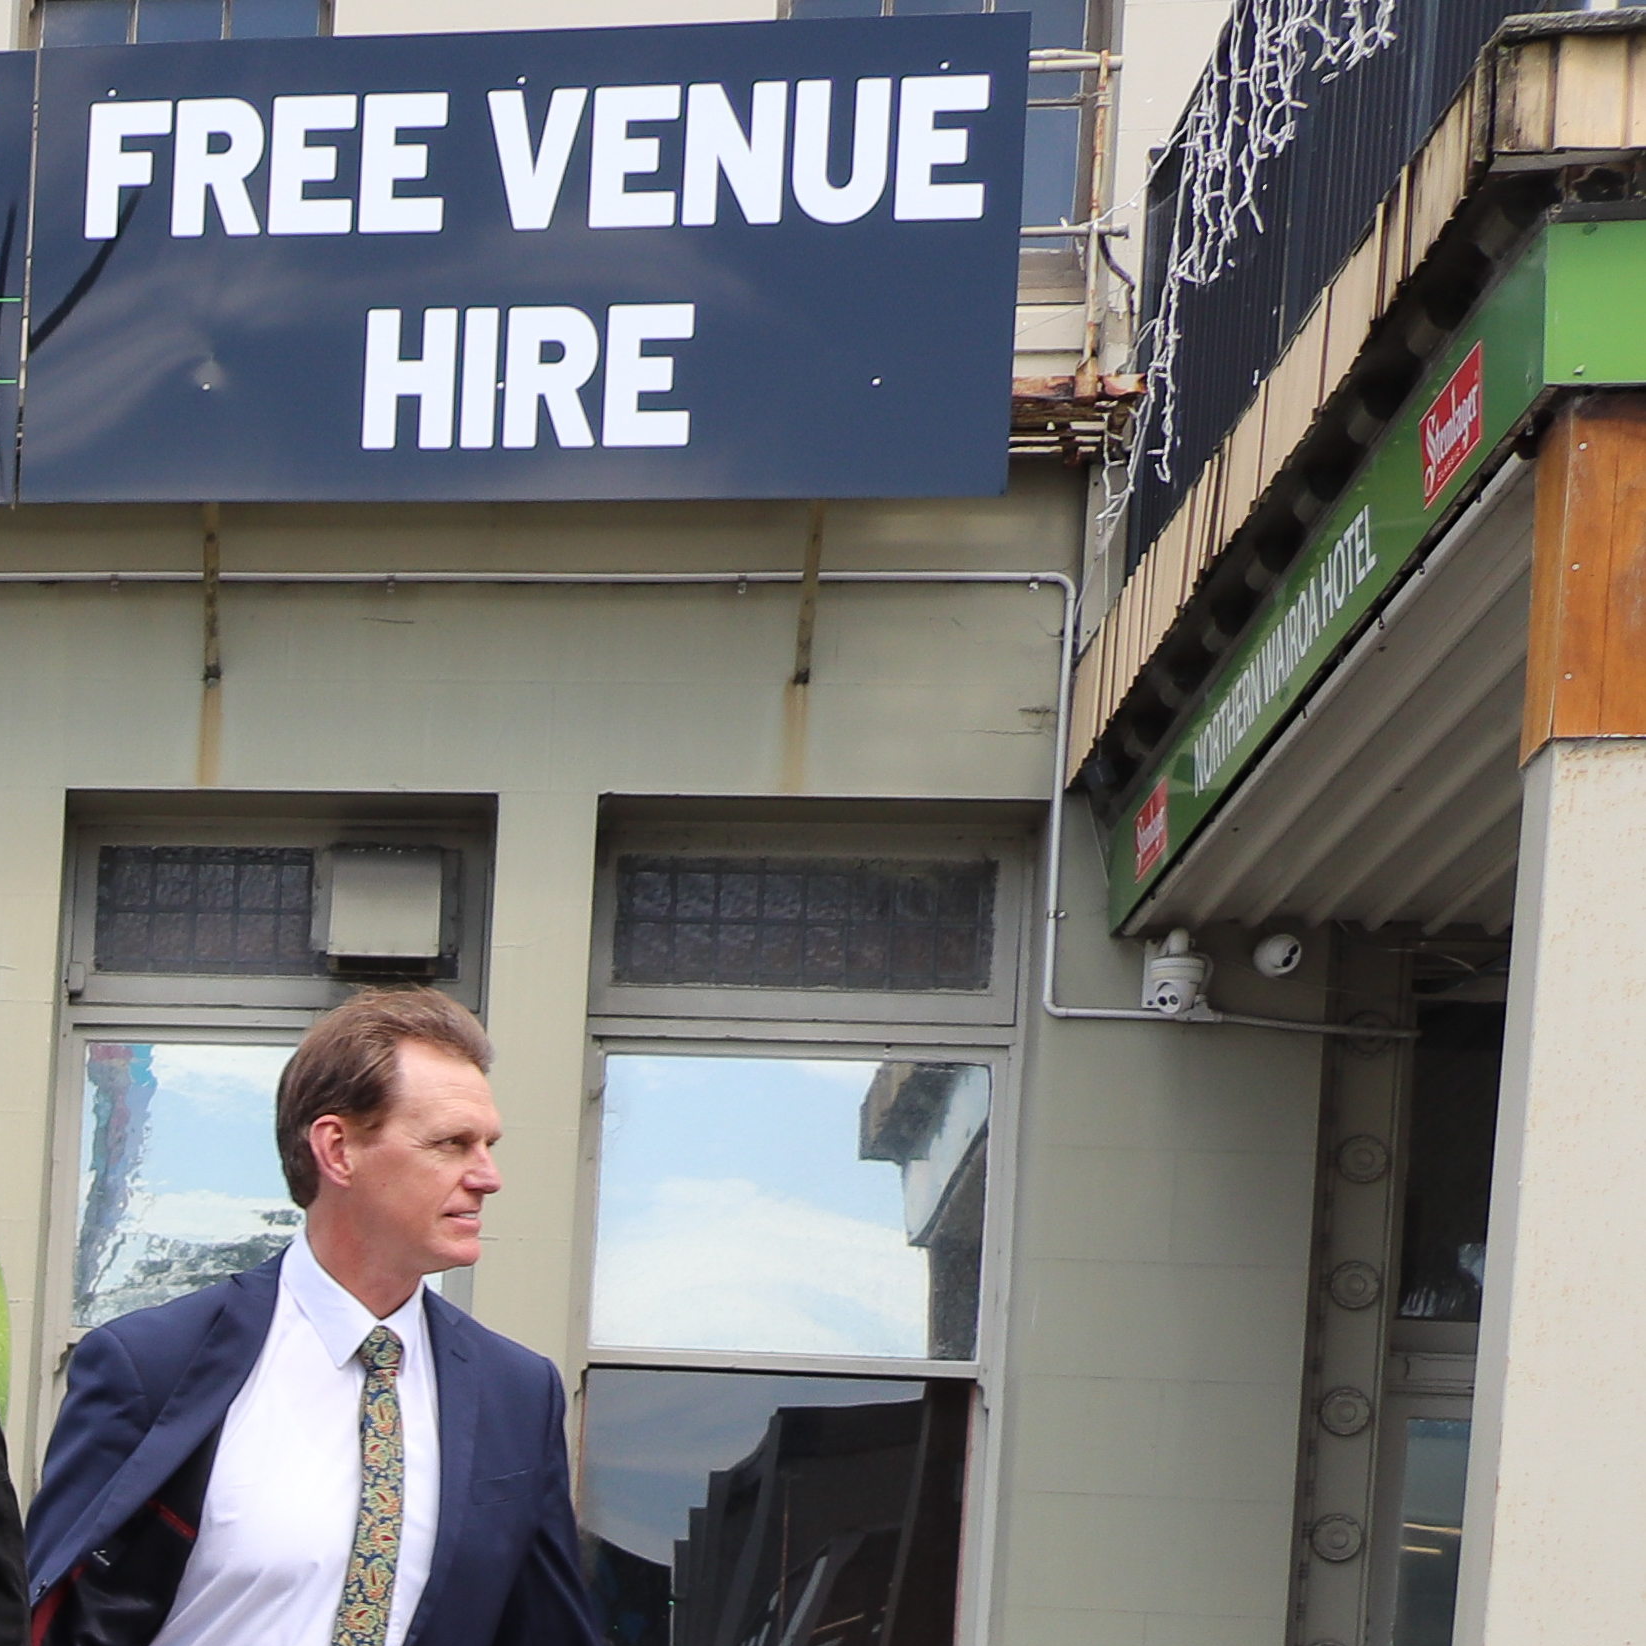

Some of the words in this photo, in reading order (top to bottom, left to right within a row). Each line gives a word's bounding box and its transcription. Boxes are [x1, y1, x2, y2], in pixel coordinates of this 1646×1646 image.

[84, 91, 450, 240] FREE
[486, 73, 992, 231] VENUE
[361, 302, 696, 449] HIRE
[1194, 653, 1261, 798] NORTHERN
[1261, 577, 1320, 705] WAIROA
[1320, 504, 1377, 629] HOTEL
